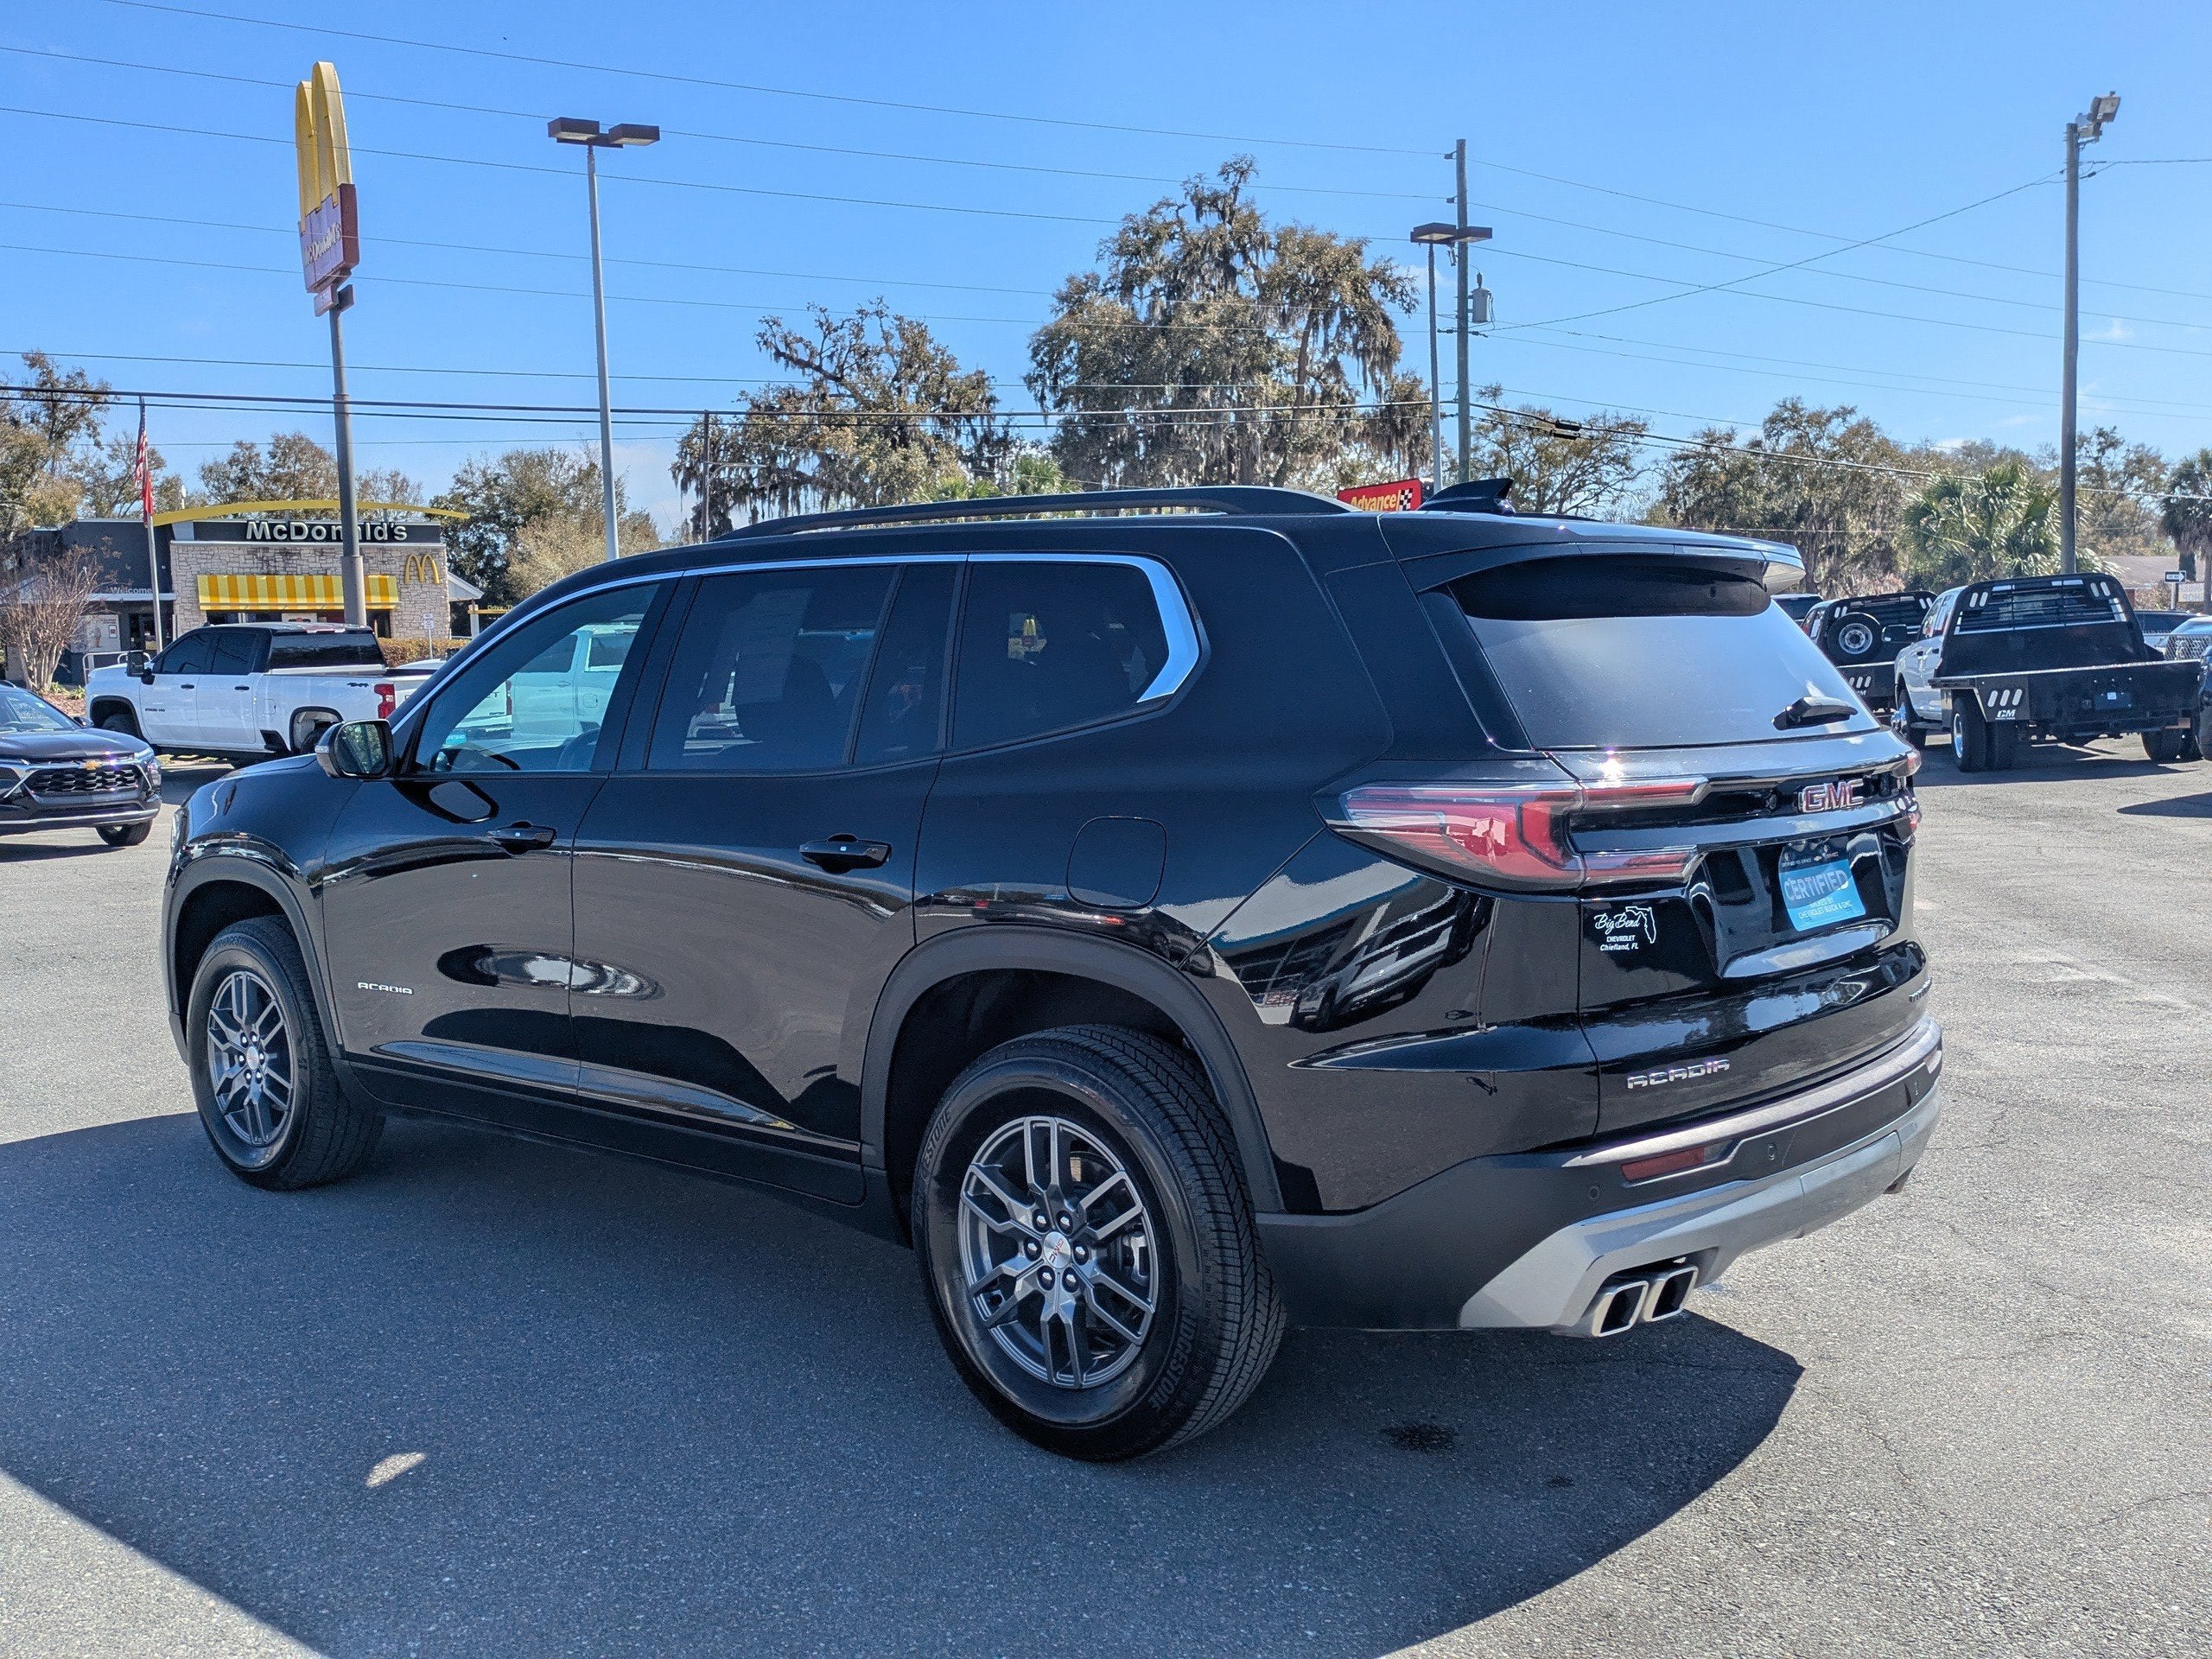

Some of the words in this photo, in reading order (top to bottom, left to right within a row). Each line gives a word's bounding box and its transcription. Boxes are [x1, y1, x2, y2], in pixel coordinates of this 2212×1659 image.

[1350, 493, 1397, 511] Advance
[246, 521, 408, 541] McDonld's
[1802, 779, 1864, 813] GMC
[1783, 869, 1849, 901] CERTIFIED
[1594, 912, 1614, 934] Big
[1613, 912, 1641, 929] Bend
[357, 982, 413, 995] ACADIA
[1627, 1058, 1730, 1090] ACADIA
